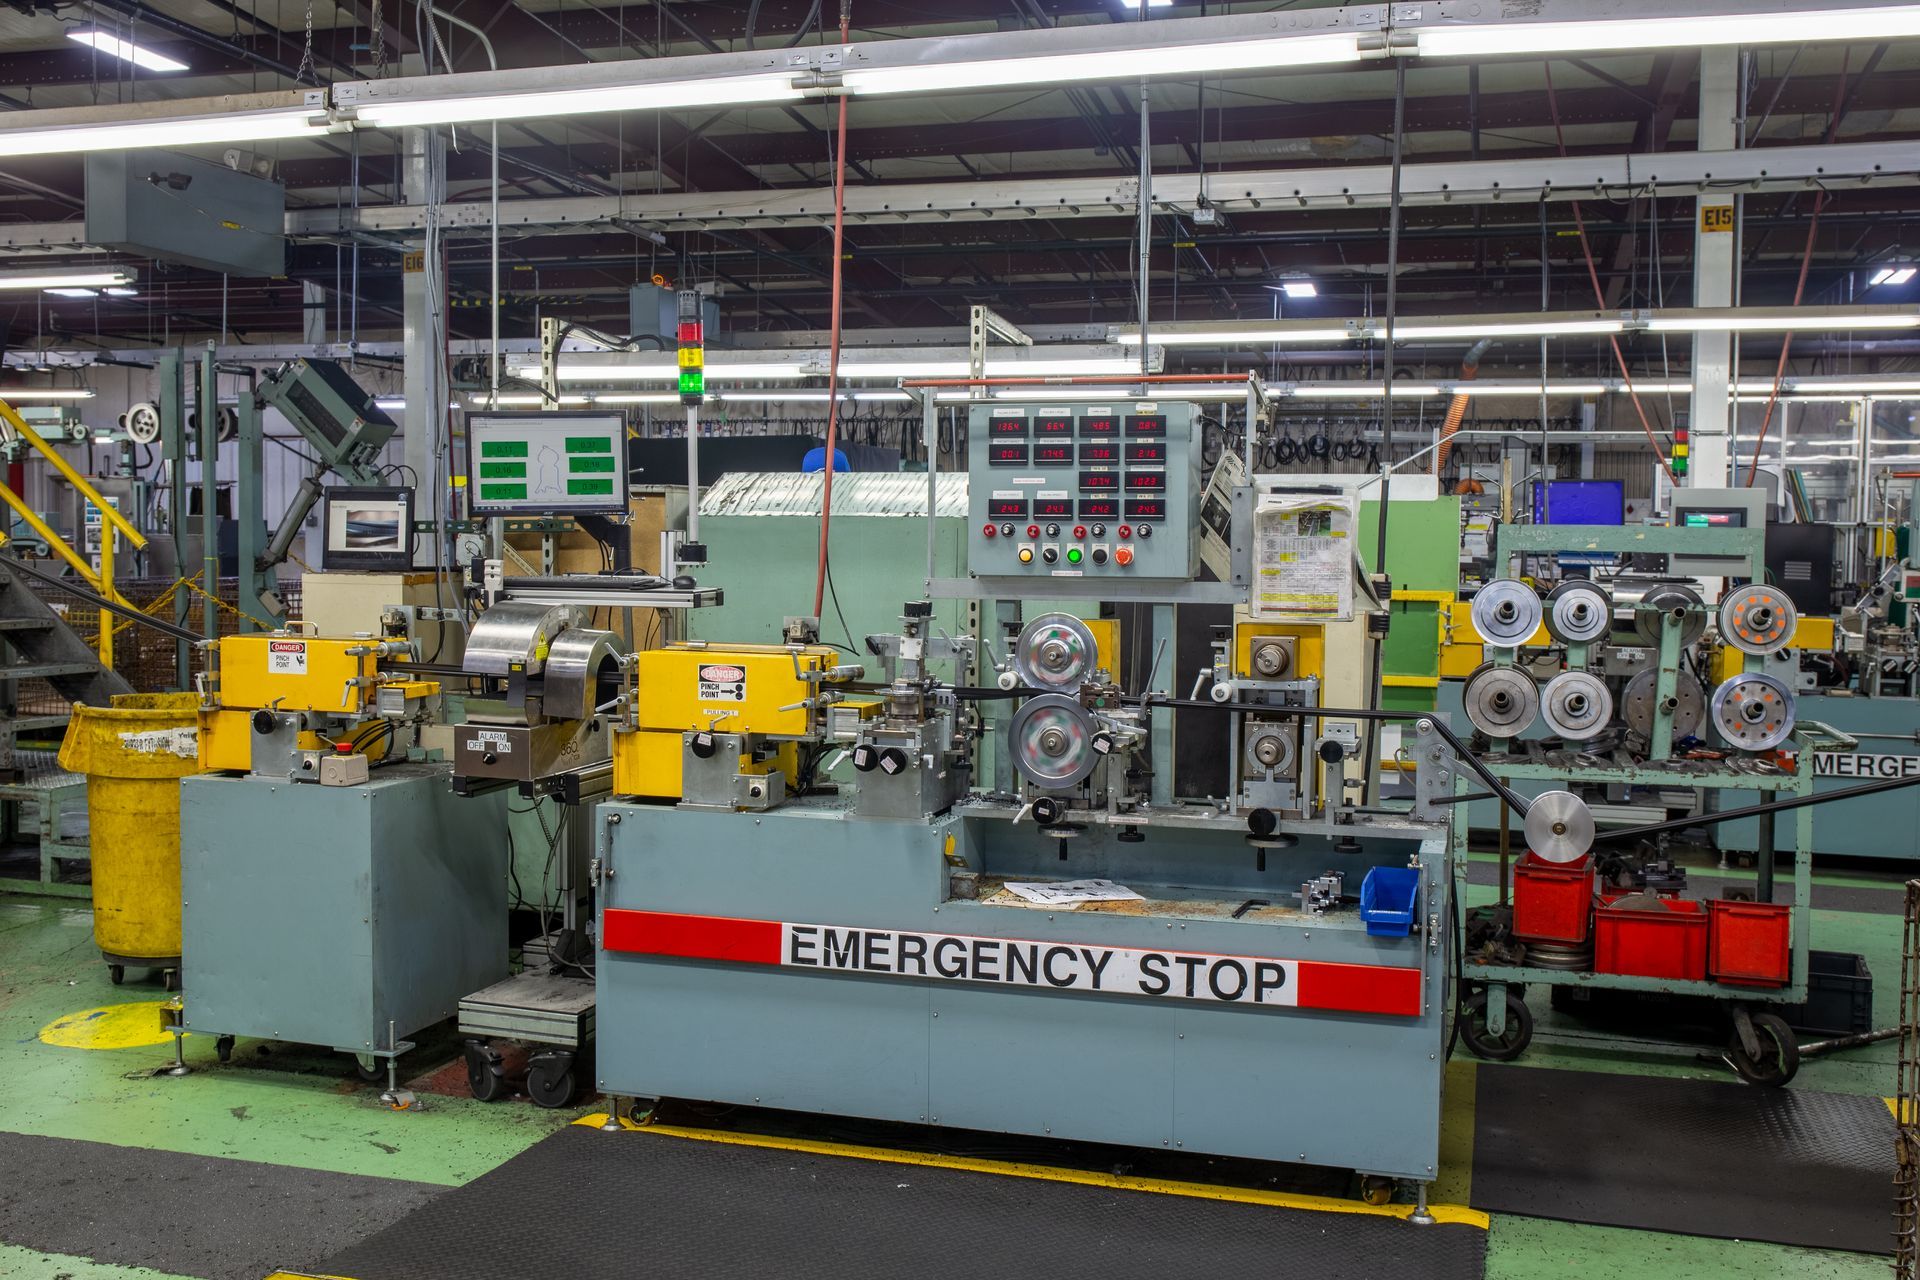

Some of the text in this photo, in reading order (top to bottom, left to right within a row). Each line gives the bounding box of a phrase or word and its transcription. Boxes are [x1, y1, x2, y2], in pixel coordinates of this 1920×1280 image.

[1704, 208, 1732, 226] E15
[405, 255, 425, 270] E16
[706, 669, 739, 680] DANGER
[700, 683, 720, 691] PINCH
[480, 732, 506, 741] ALARM
[468, 741, 510, 751] OFF ON
[791, 926, 1286, 1002] EMERGENCY STOP
